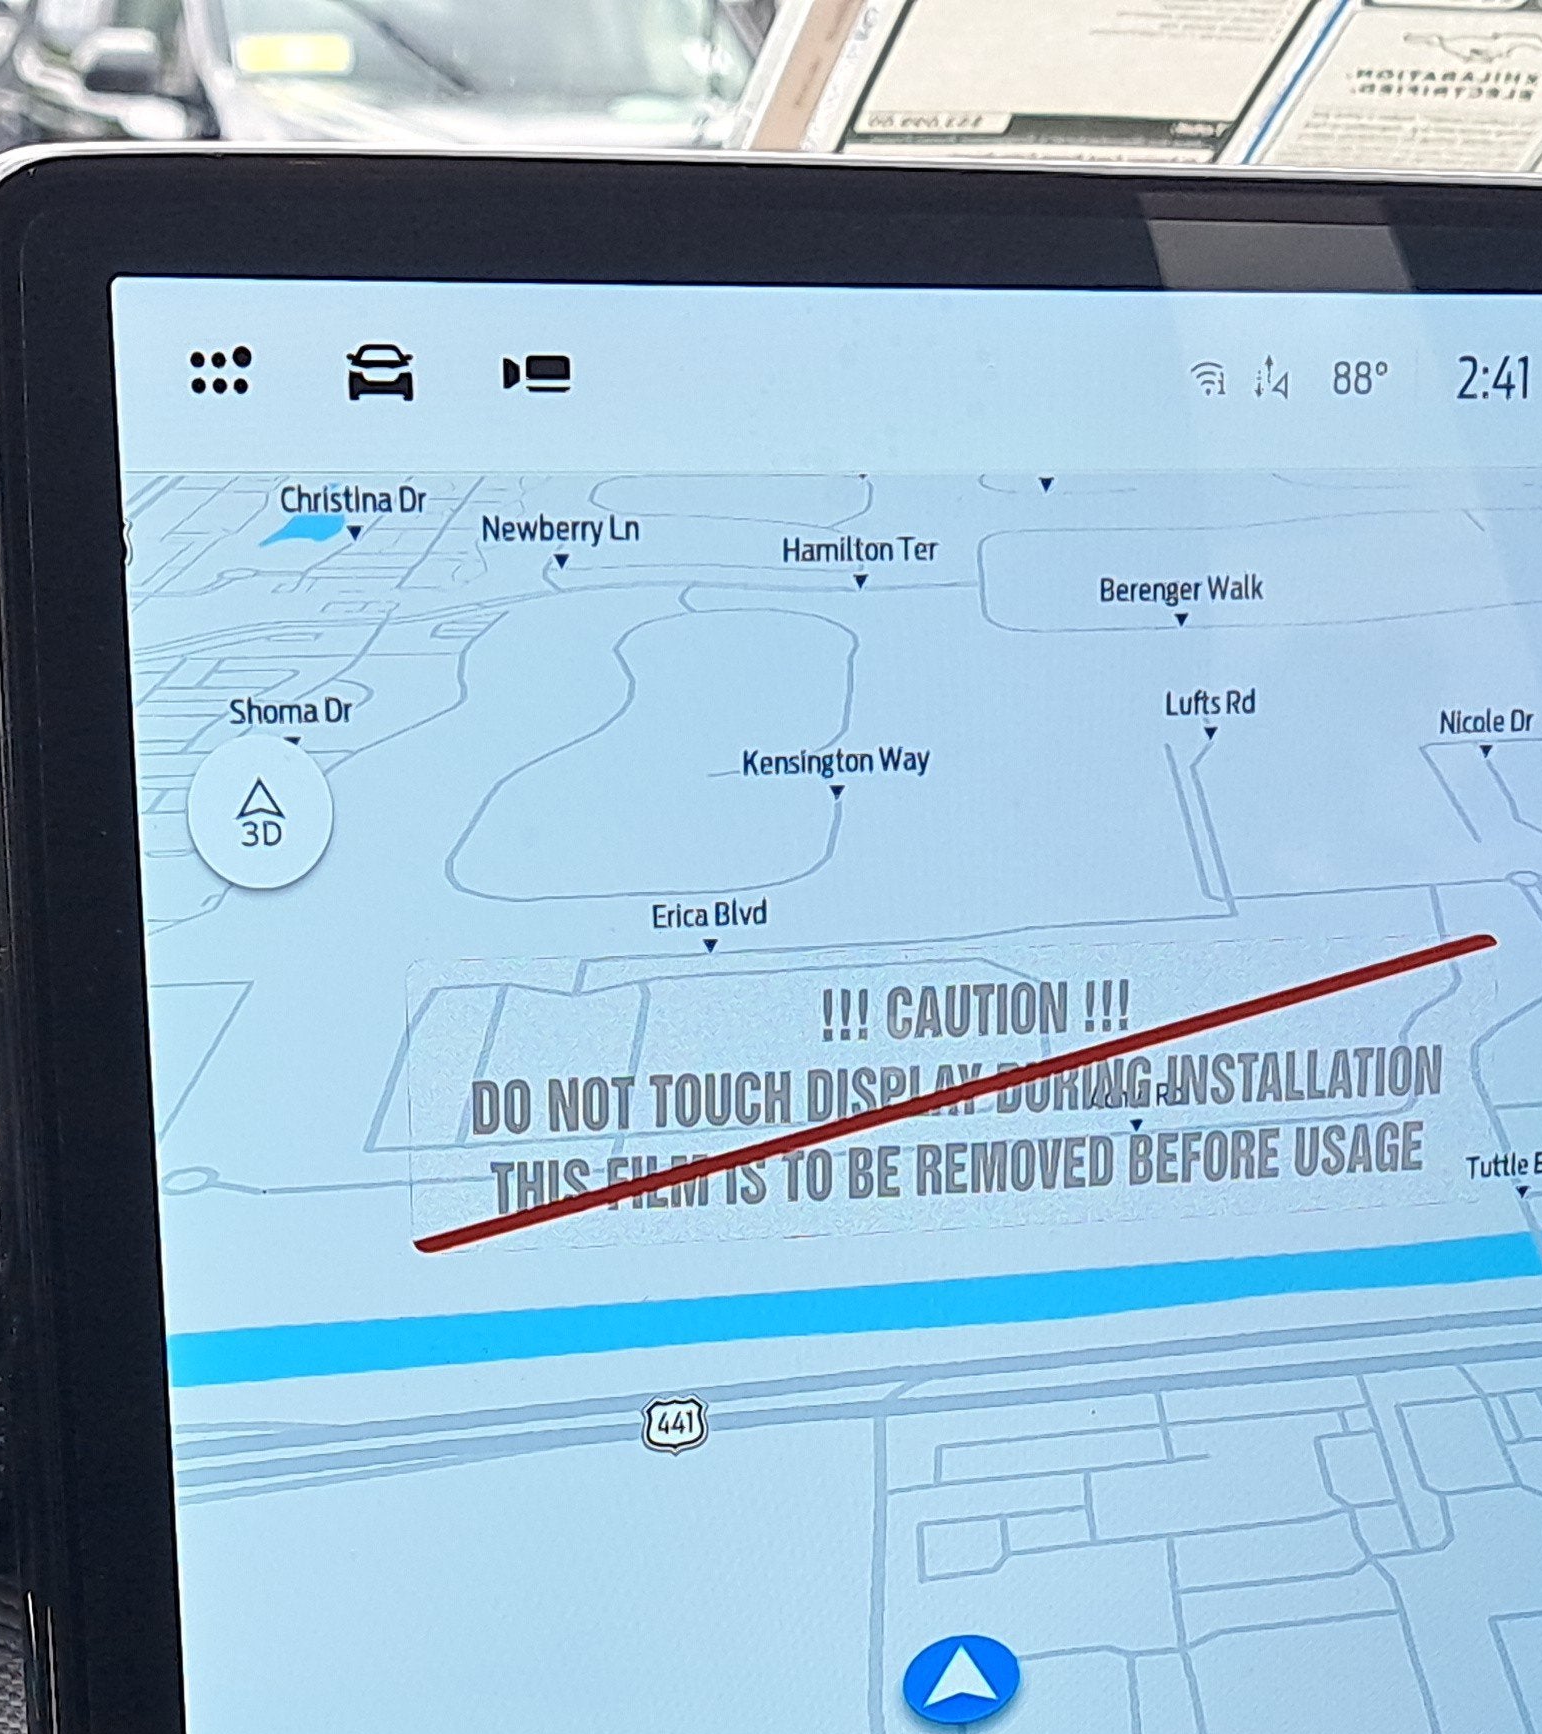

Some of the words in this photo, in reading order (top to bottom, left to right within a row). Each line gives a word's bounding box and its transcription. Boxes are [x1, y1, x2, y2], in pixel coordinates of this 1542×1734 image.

[1457, 354, 1531, 401] 2:41
[280, 486, 391, 514] Christina
[397, 487, 426, 513] Dr
[481, 516, 603, 546] Newberry
[608, 516, 640, 541] Ln
[782, 537, 893, 563] Hamilton
[895, 537, 938, 563] Ter
[1100, 576, 1202, 607] Berenger
[1206, 575, 1264, 602] Walk
[229, 698, 320, 724] Shoma
[325, 697, 352, 724] Dr
[1165, 691, 1220, 717] Lufts
[1225, 690, 1256, 717] Rd
[1439, 708, 1504, 734] Nicole
[1509, 708, 1534, 734] Dr
[742, 748, 874, 778] Kensington
[878, 747, 930, 776] Way
[240, 821, 282, 847] 3D
[652, 903, 707, 929] Erica
[714, 899, 768, 926] Blvd
[886, 981, 1067, 1040] CAUTION
[471, 1078, 531, 1135] DO
[547, 1075, 635, 1132] NOT
[649, 1070, 791, 1128] TOUCH
[1163, 1044, 1444, 1106] INSTALLATION
[491, 1158, 591, 1214] THIS
[726, 1158, 766, 1205] IS
[782, 1147, 833, 1202] TO
[847, 1144, 901, 1198] BE
[915, 1135, 1115, 1196] REMOVED
[1128, 1127, 1279, 1186] BEFORE
[1294, 1121, 1424, 1177] USAGE
[1466, 1153, 1529, 1180] Tuttle
[656, 1409, 695, 1436] 441
